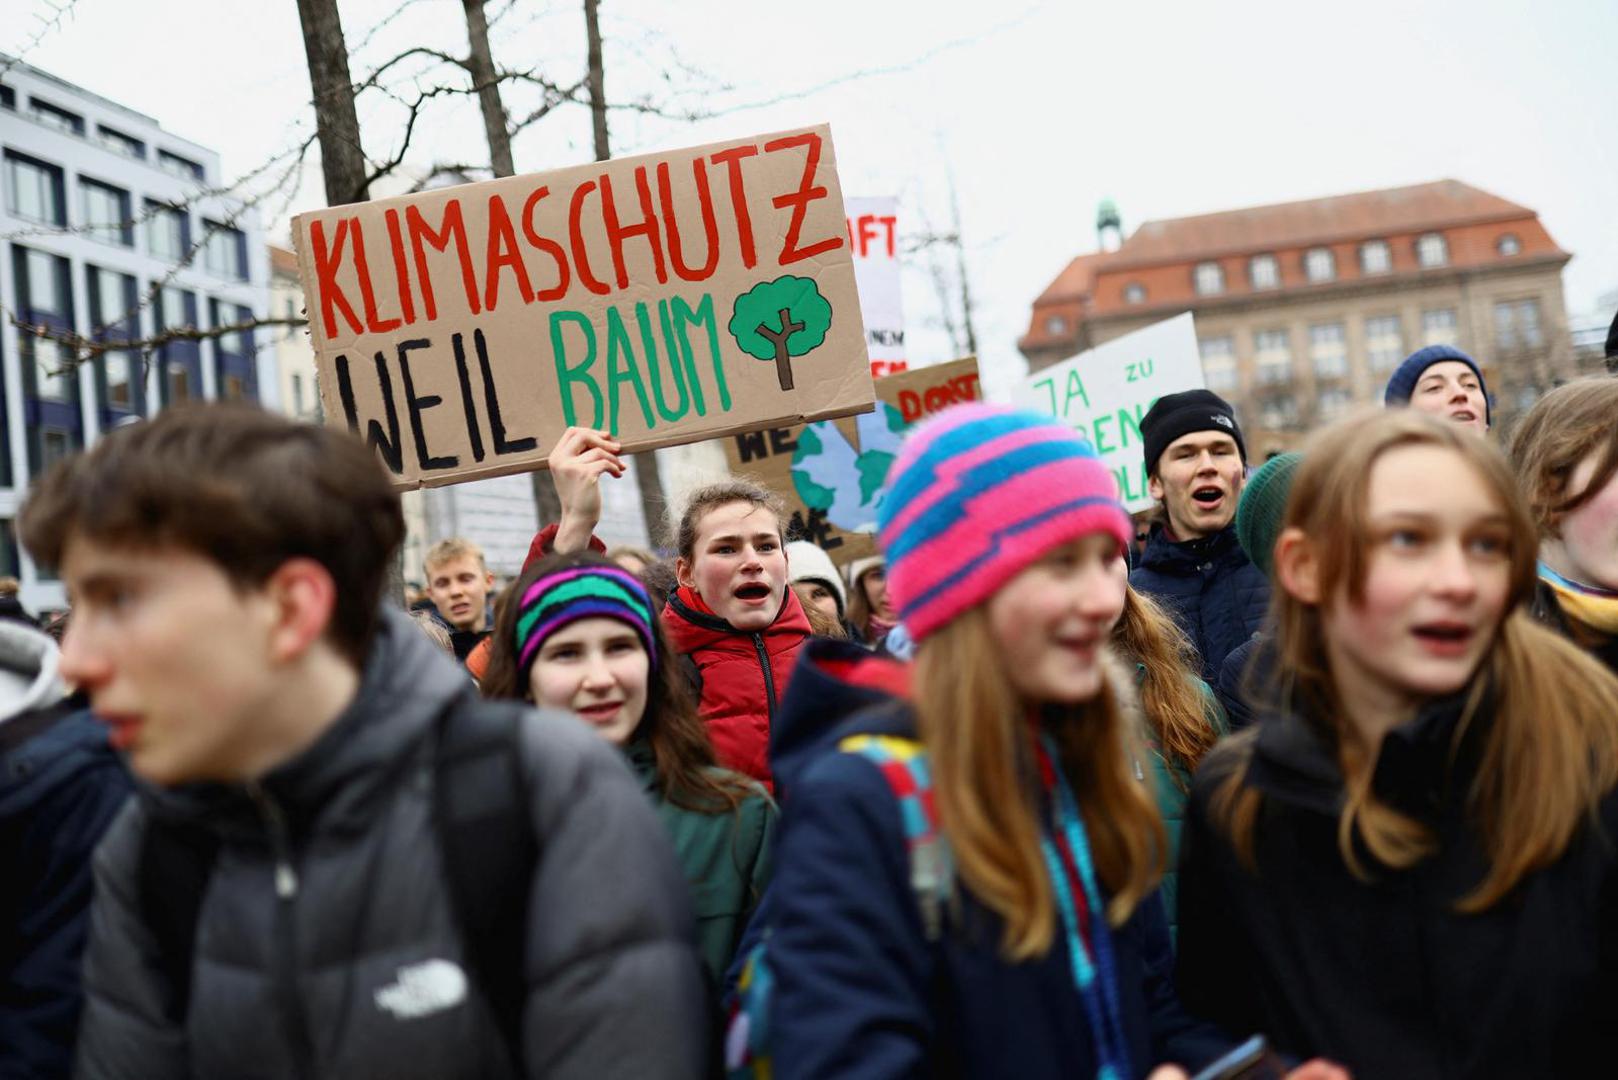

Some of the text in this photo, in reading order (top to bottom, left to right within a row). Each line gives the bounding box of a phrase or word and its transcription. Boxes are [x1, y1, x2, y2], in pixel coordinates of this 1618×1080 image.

[310, 132, 843, 339] KLIMASCHUTZ
[847, 214, 896, 257] FT
[335, 328, 537, 474] WEIL
[549, 293, 732, 436] BAUM
[1033, 357, 1153, 418] JA ZU
[736, 427, 798, 463] WE
